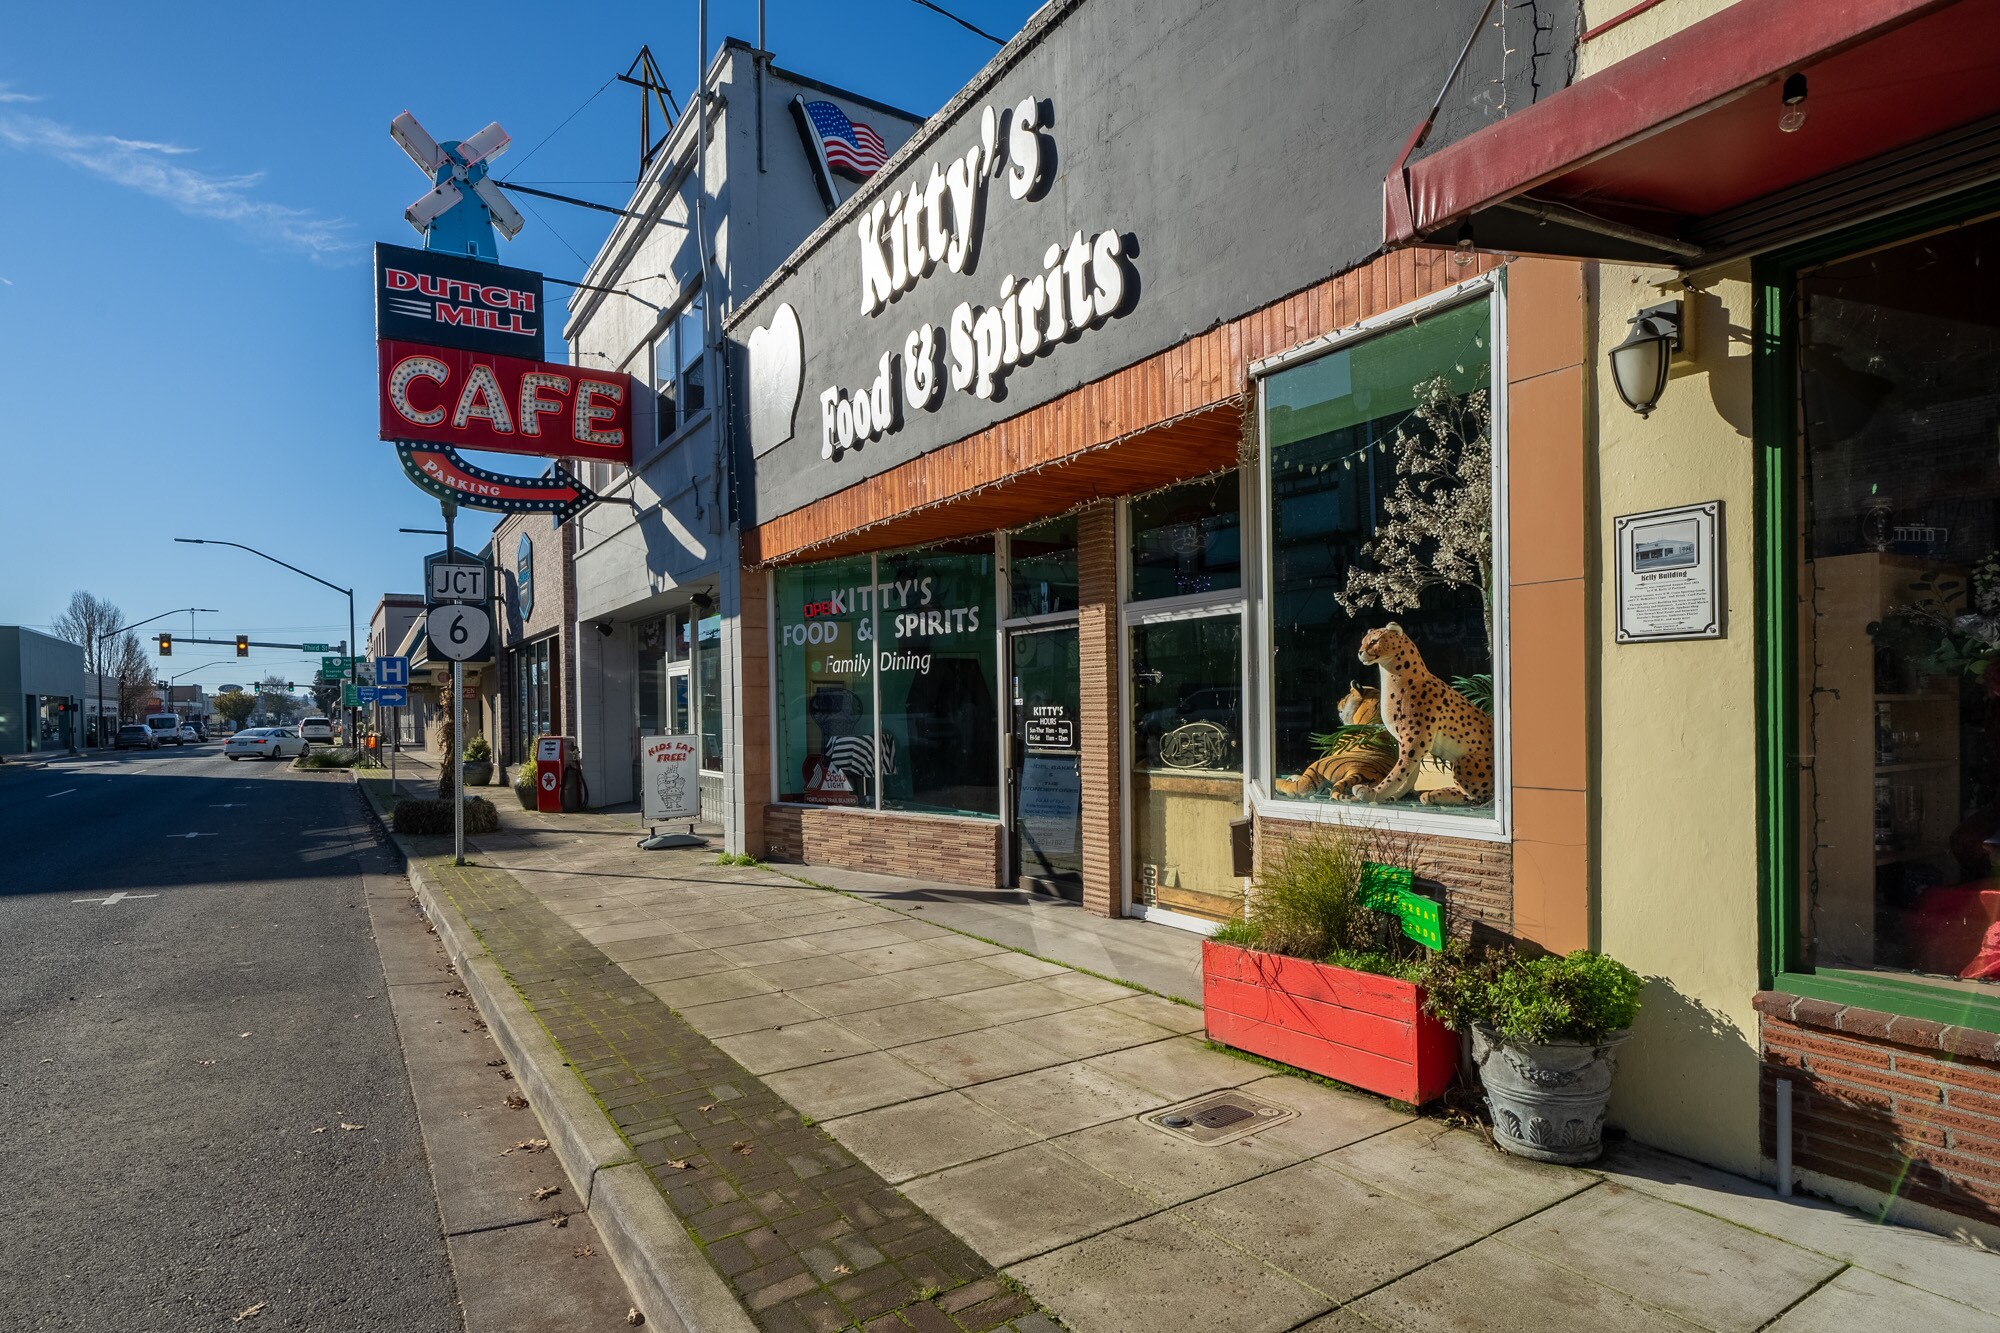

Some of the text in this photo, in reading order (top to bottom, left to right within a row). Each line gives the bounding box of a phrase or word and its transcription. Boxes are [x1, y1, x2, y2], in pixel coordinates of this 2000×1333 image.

[858, 95, 1040, 316] Kitty's
[385, 267, 536, 313] DUTCH
[435, 302, 537, 336] MILL
[820, 228, 1125, 460] Food & Spirits
[388, 355, 625, 447] CAFE
[422, 459, 501, 496] PARKING
[436, 570, 481, 595] JCT
[1641, 571, 1688, 583] Kelly Building
[831, 576, 933, 615] KITTY'S
[449, 613, 469, 645] 6
[783, 605, 980, 647] FOOD & SPIRITS
[304, 644, 320, 652] Third
[382, 660, 402, 682] H
[825, 650, 931, 678] Family Dining
[1033, 706, 1064, 716] KITTY'S
[1040, 717, 1057, 725] HOURS
[648, 742, 695, 757] KIDS EAT
[656, 753, 687, 763] FREE!
[1160, 731, 1222, 758] OPEN
[825, 771, 847, 782] Coors
[1401, 902, 1436, 923] GREAT
